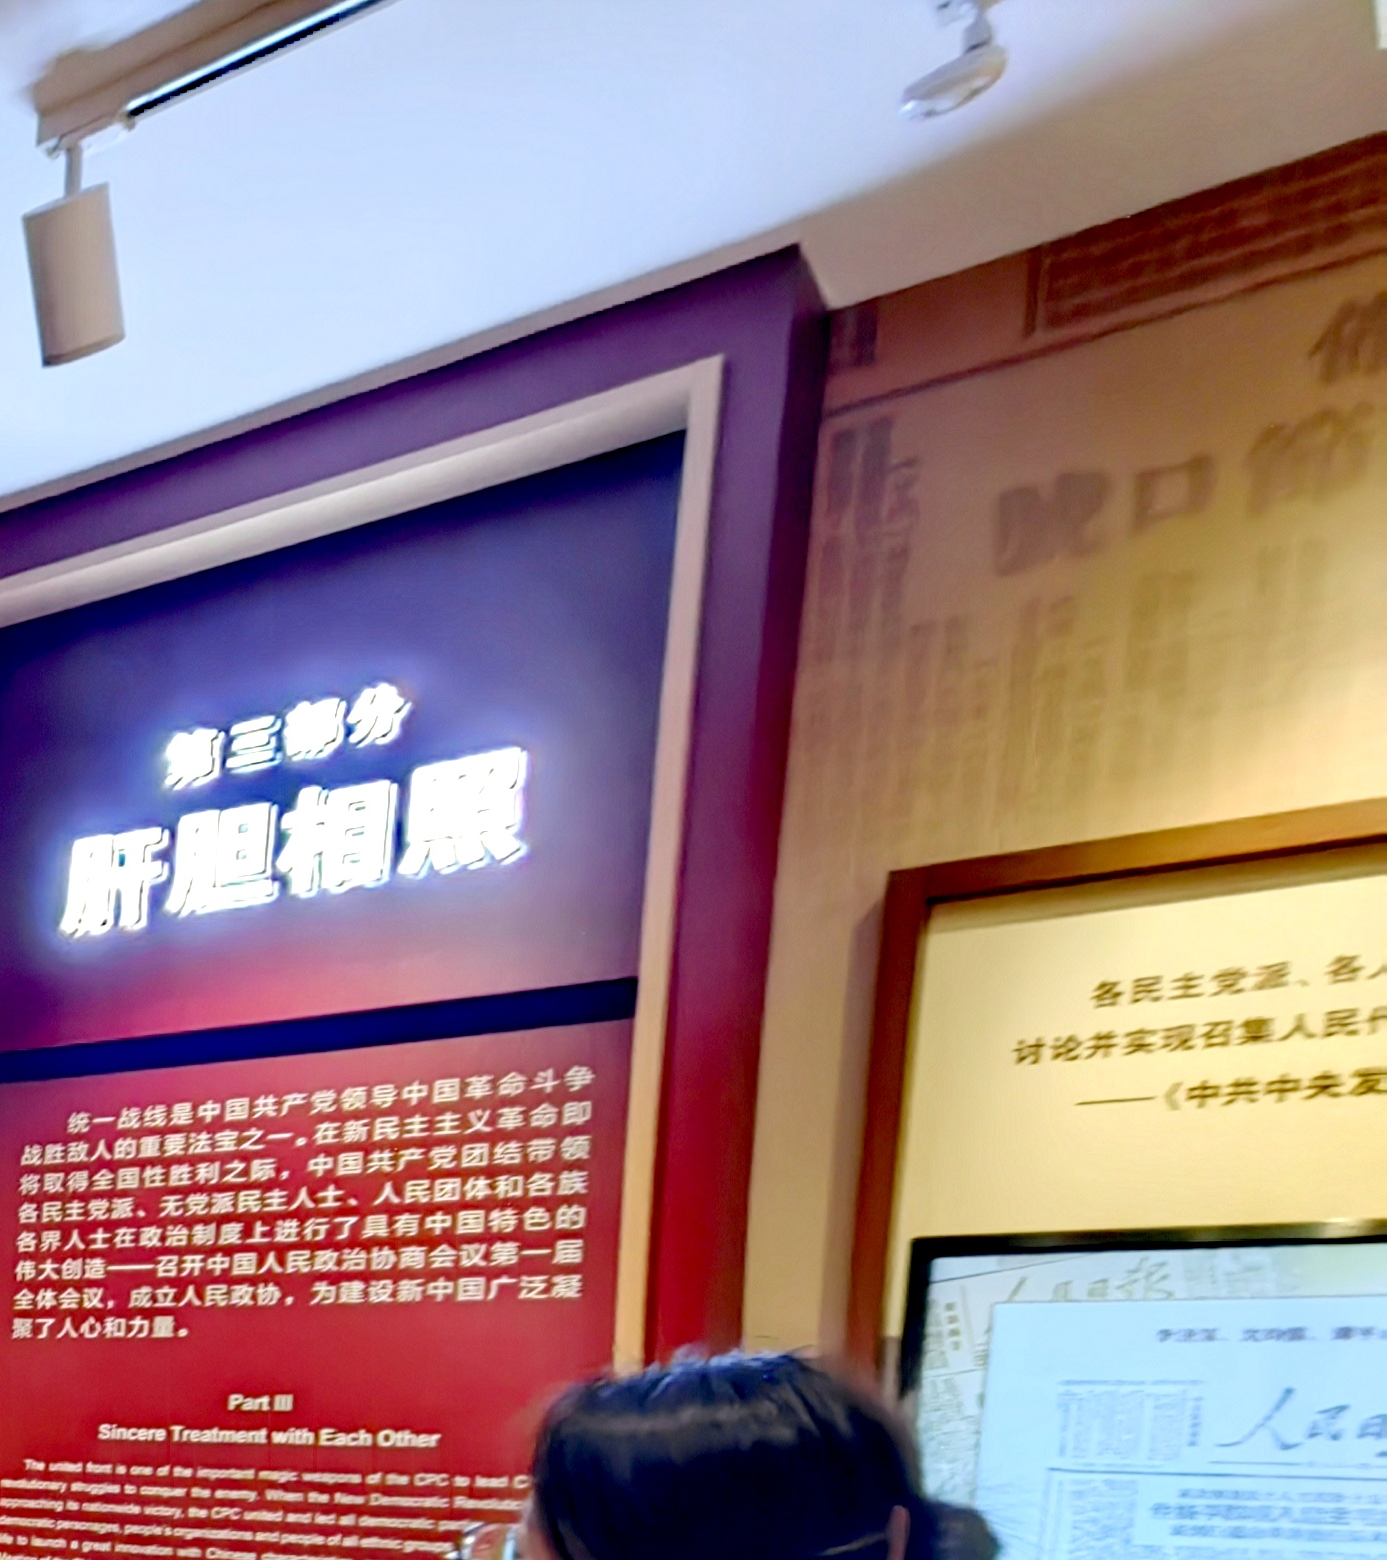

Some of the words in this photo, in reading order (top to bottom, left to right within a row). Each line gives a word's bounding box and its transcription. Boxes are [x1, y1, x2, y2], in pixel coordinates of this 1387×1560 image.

[163, 682, 412, 790] 第三部分
[59, 747, 530, 939] 肝胆相照
[67, 1065, 596, 1135] 统一战线是中国共产党领导中国革命斗争
[20, 1101, 593, 1166] 战胜敌人的重要法宝之一。在新民主主义革命即
[18, 1135, 593, 1196] 将取得全国性胜利之际，中国共产党团结带领
[17, 1169, 589, 1224] 各民主党派、无党派民主人士、人民团体和各族
[15, 1204, 587, 1253] 各界人士在政治制度上进行了具有中国特色的
[11, 1315, 190, 1340] 聚了人心和力量。
[227, 1393, 271, 1411] Part
[273, 1394, 294, 1411] III
[98, 1423, 167, 1442] Sincere
[170, 1425, 268, 1445] Treatment
[271, 1427, 315, 1446] with
[318, 1428, 373, 1447] Each
[377, 1429, 442, 1448] Other
[24, 1459, 45, 1471] The
[413, 1473, 450, 1487] CPC
[211, 1507, 242, 1520] CPC
